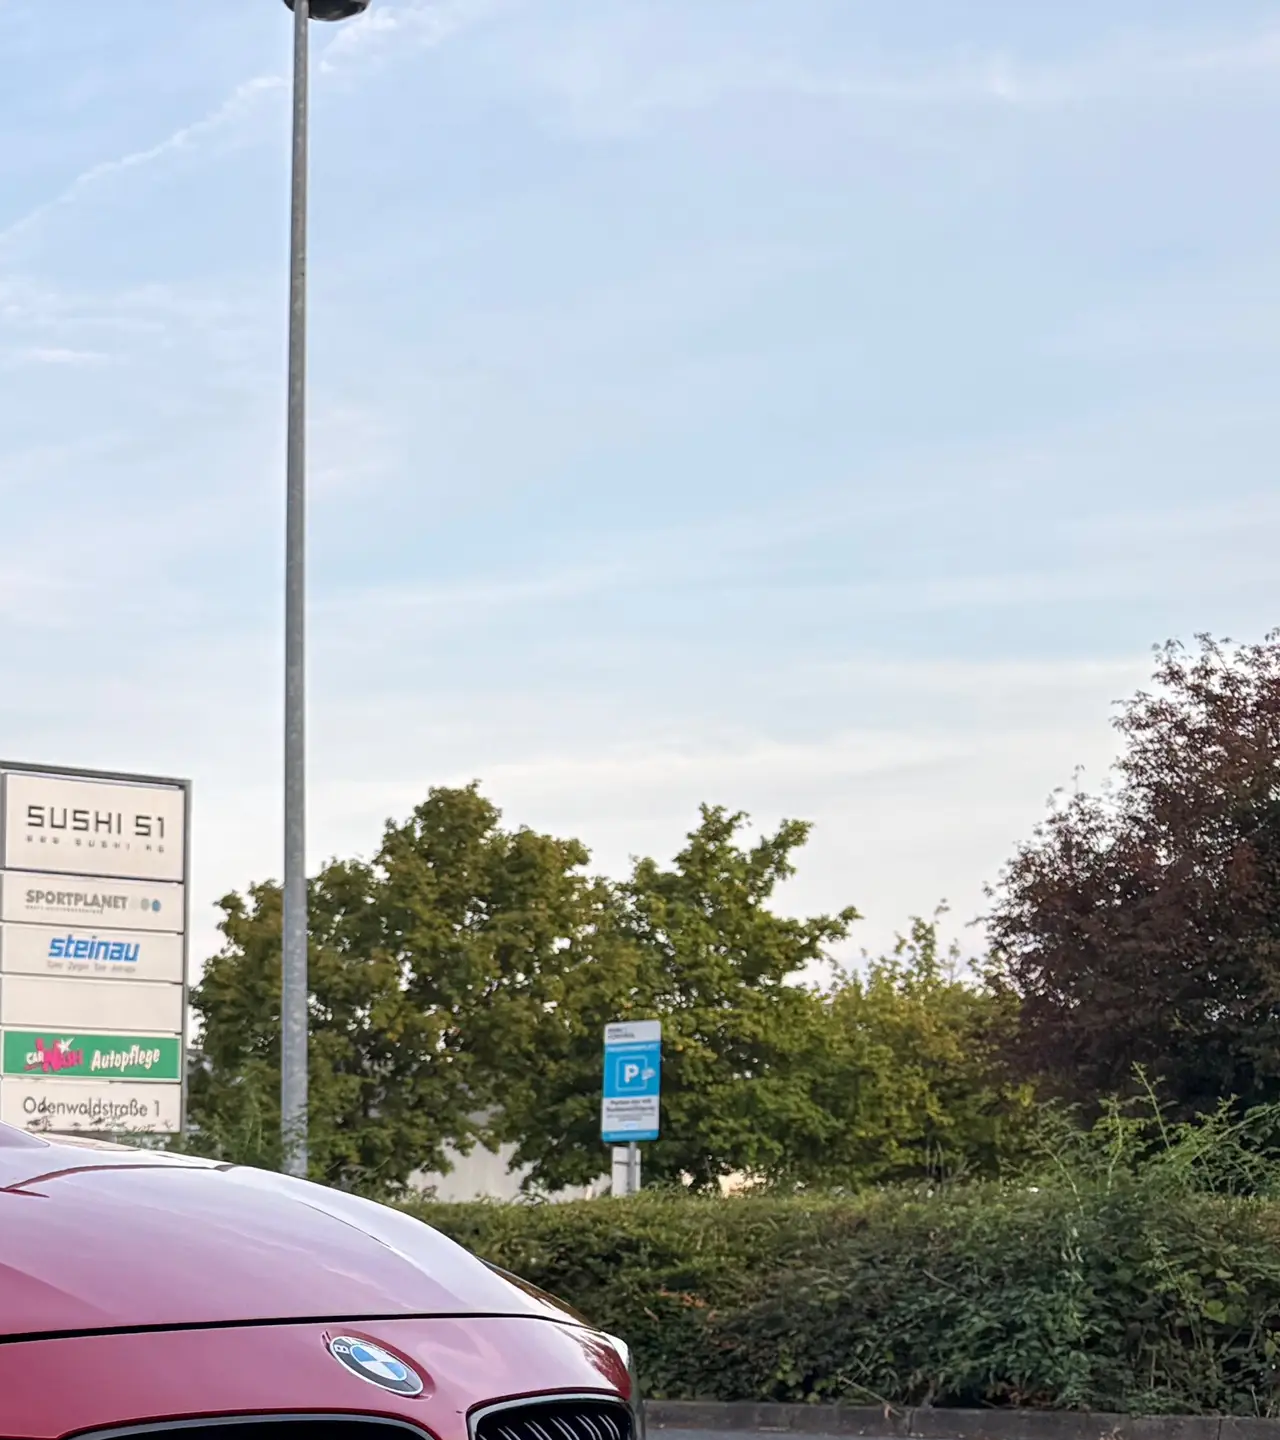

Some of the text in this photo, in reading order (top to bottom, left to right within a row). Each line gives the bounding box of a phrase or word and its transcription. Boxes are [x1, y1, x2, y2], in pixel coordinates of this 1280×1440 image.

[27, 804, 122, 835] SUSHI
[25, 889, 129, 911] SPORTPLANET
[48, 934, 140, 963] steinau
[91, 1045, 160, 1072] Autopflege
[23, 1096, 160, 1117] Odenwaldstraße 1
